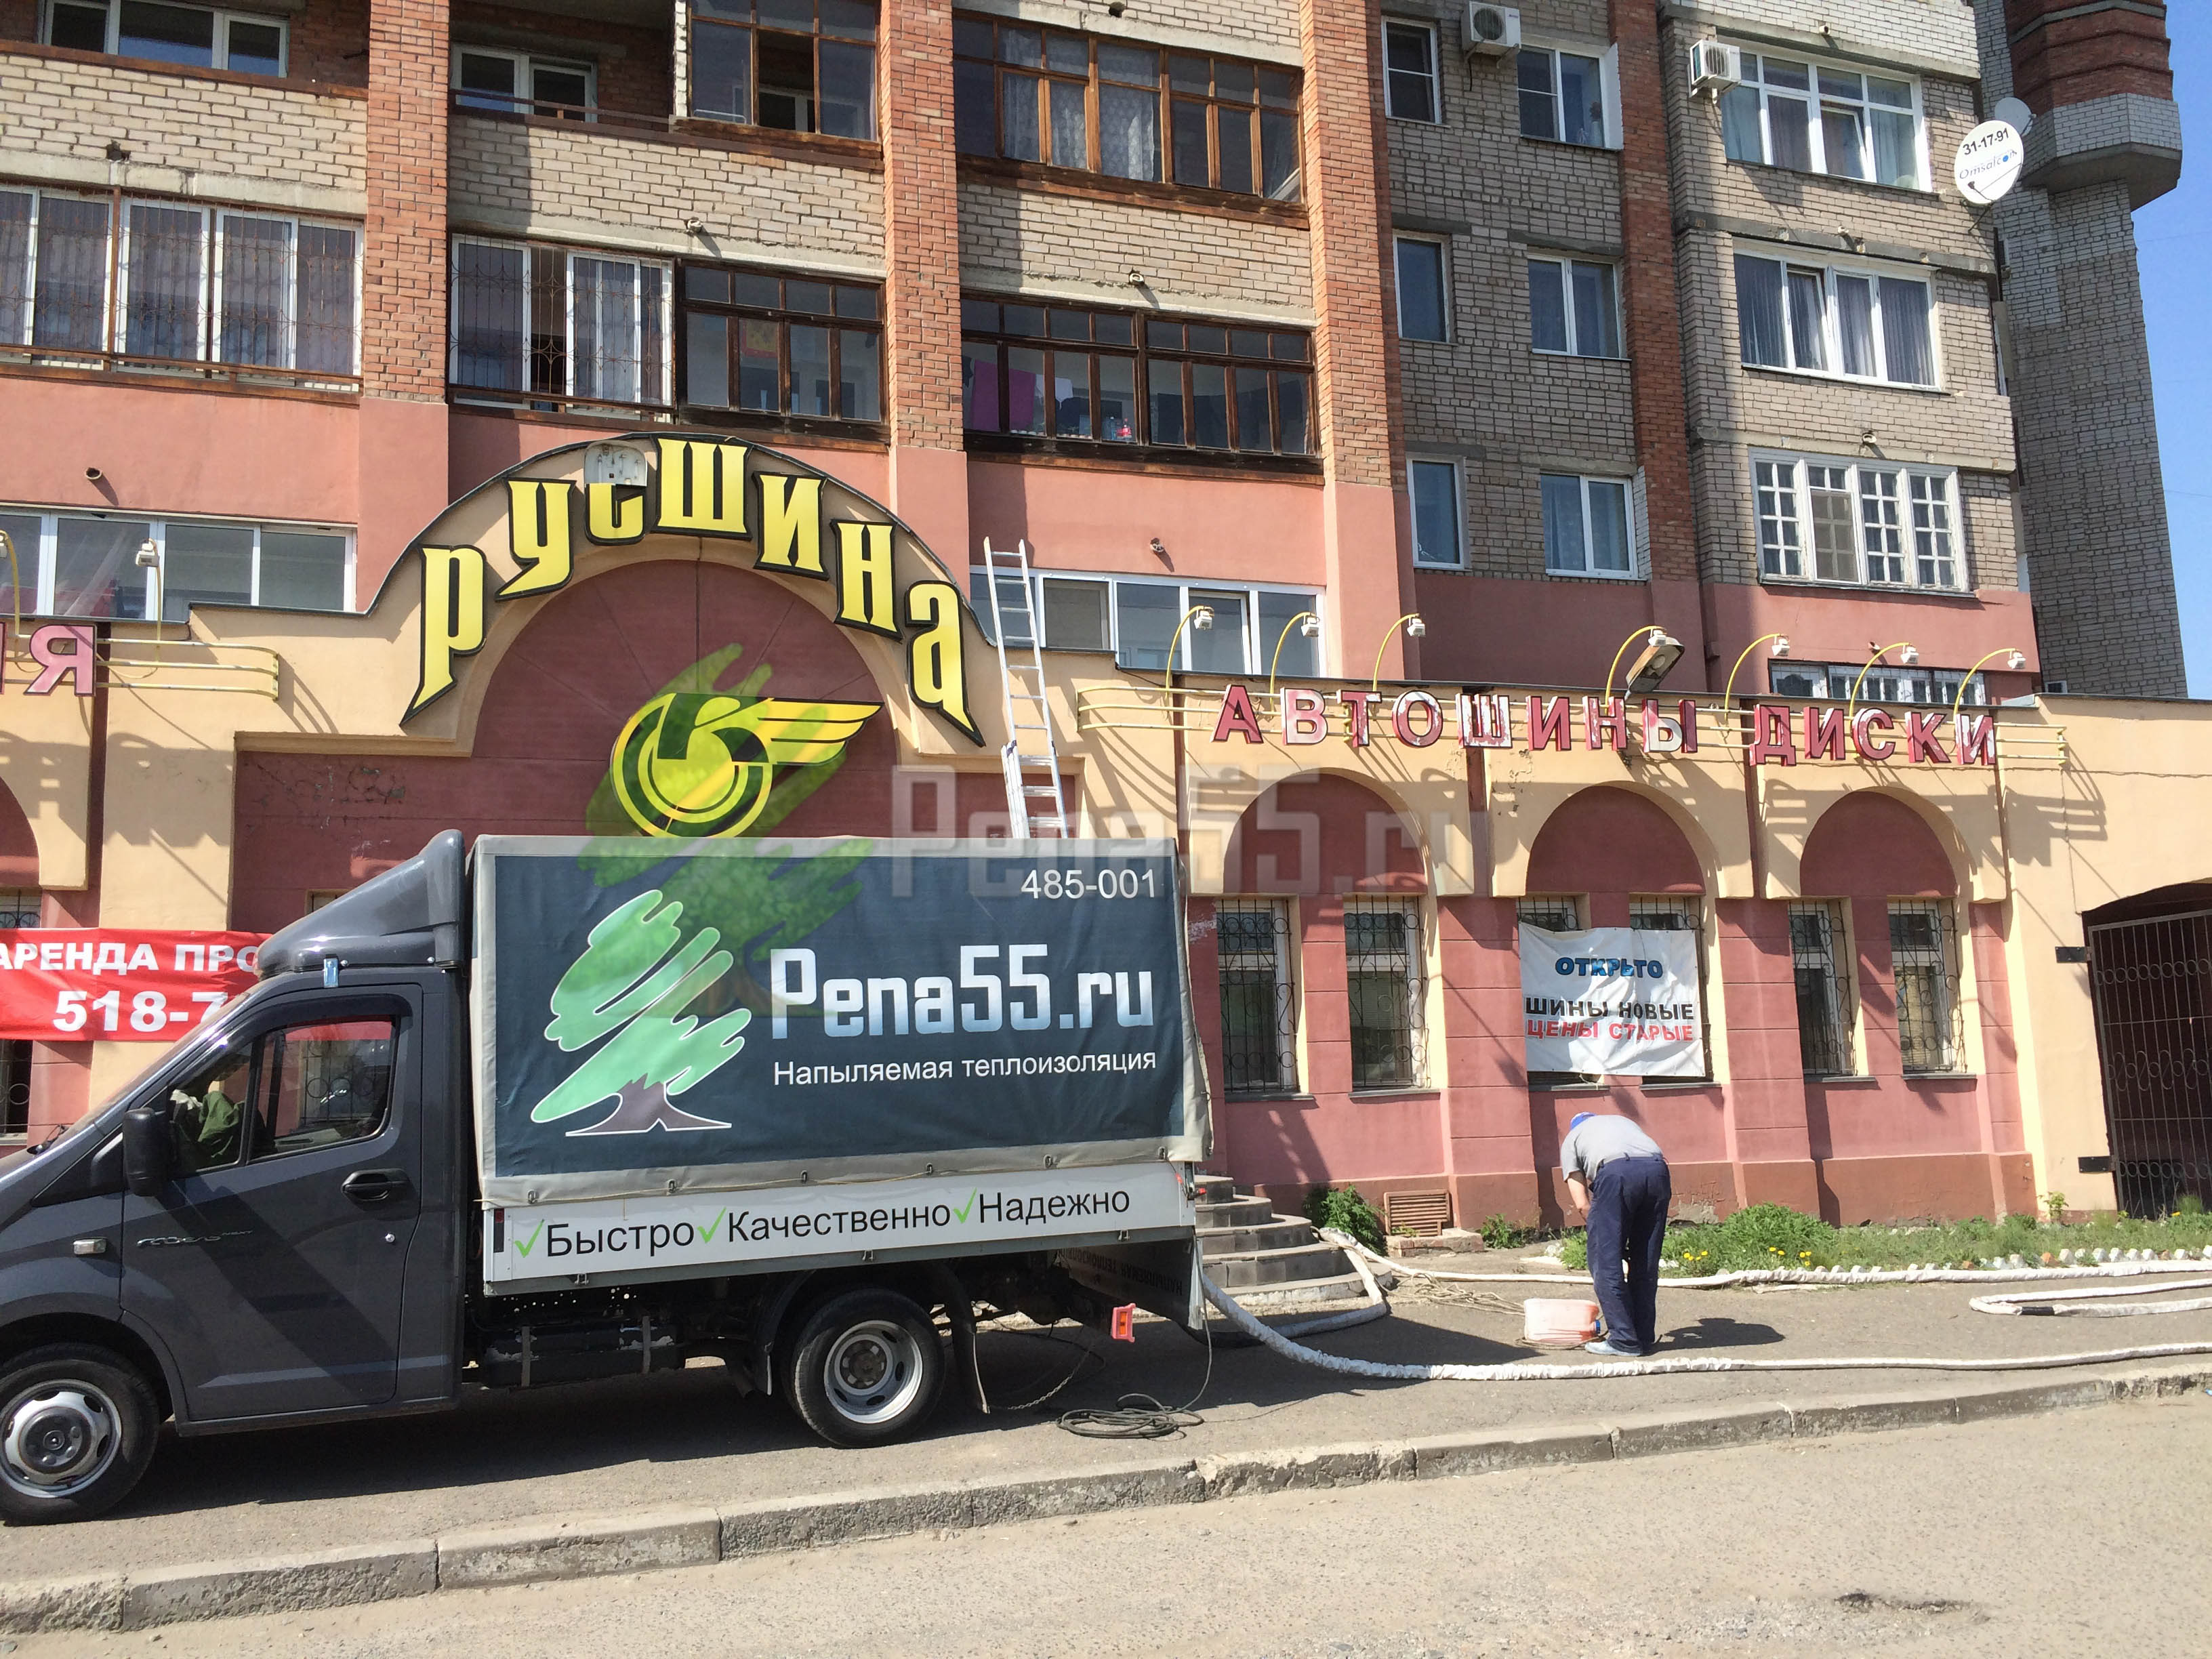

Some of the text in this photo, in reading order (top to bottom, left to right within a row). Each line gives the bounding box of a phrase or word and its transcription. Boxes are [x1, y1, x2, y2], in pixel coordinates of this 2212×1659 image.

[1963, 127, 2009, 155] 31-17-91
[0, 621, 97, 697] Я
[1211, 684, 1997, 767] АВТОШИНЫ ДИСКИ
[1021, 869, 1157, 900] 485-001
[771, 943, 1153, 1040] Pena55.ru
[1525, 997, 1694, 1019] ШИНЫ НОВЫЕ
[1527, 1019, 1693, 1042] ЦЕНЫ СТАРЫЕ
[773, 1050, 1157, 1086] Напыляемая теплоизоляция
[546, 1190, 1130, 1258] Быстро Качественно Надежно
